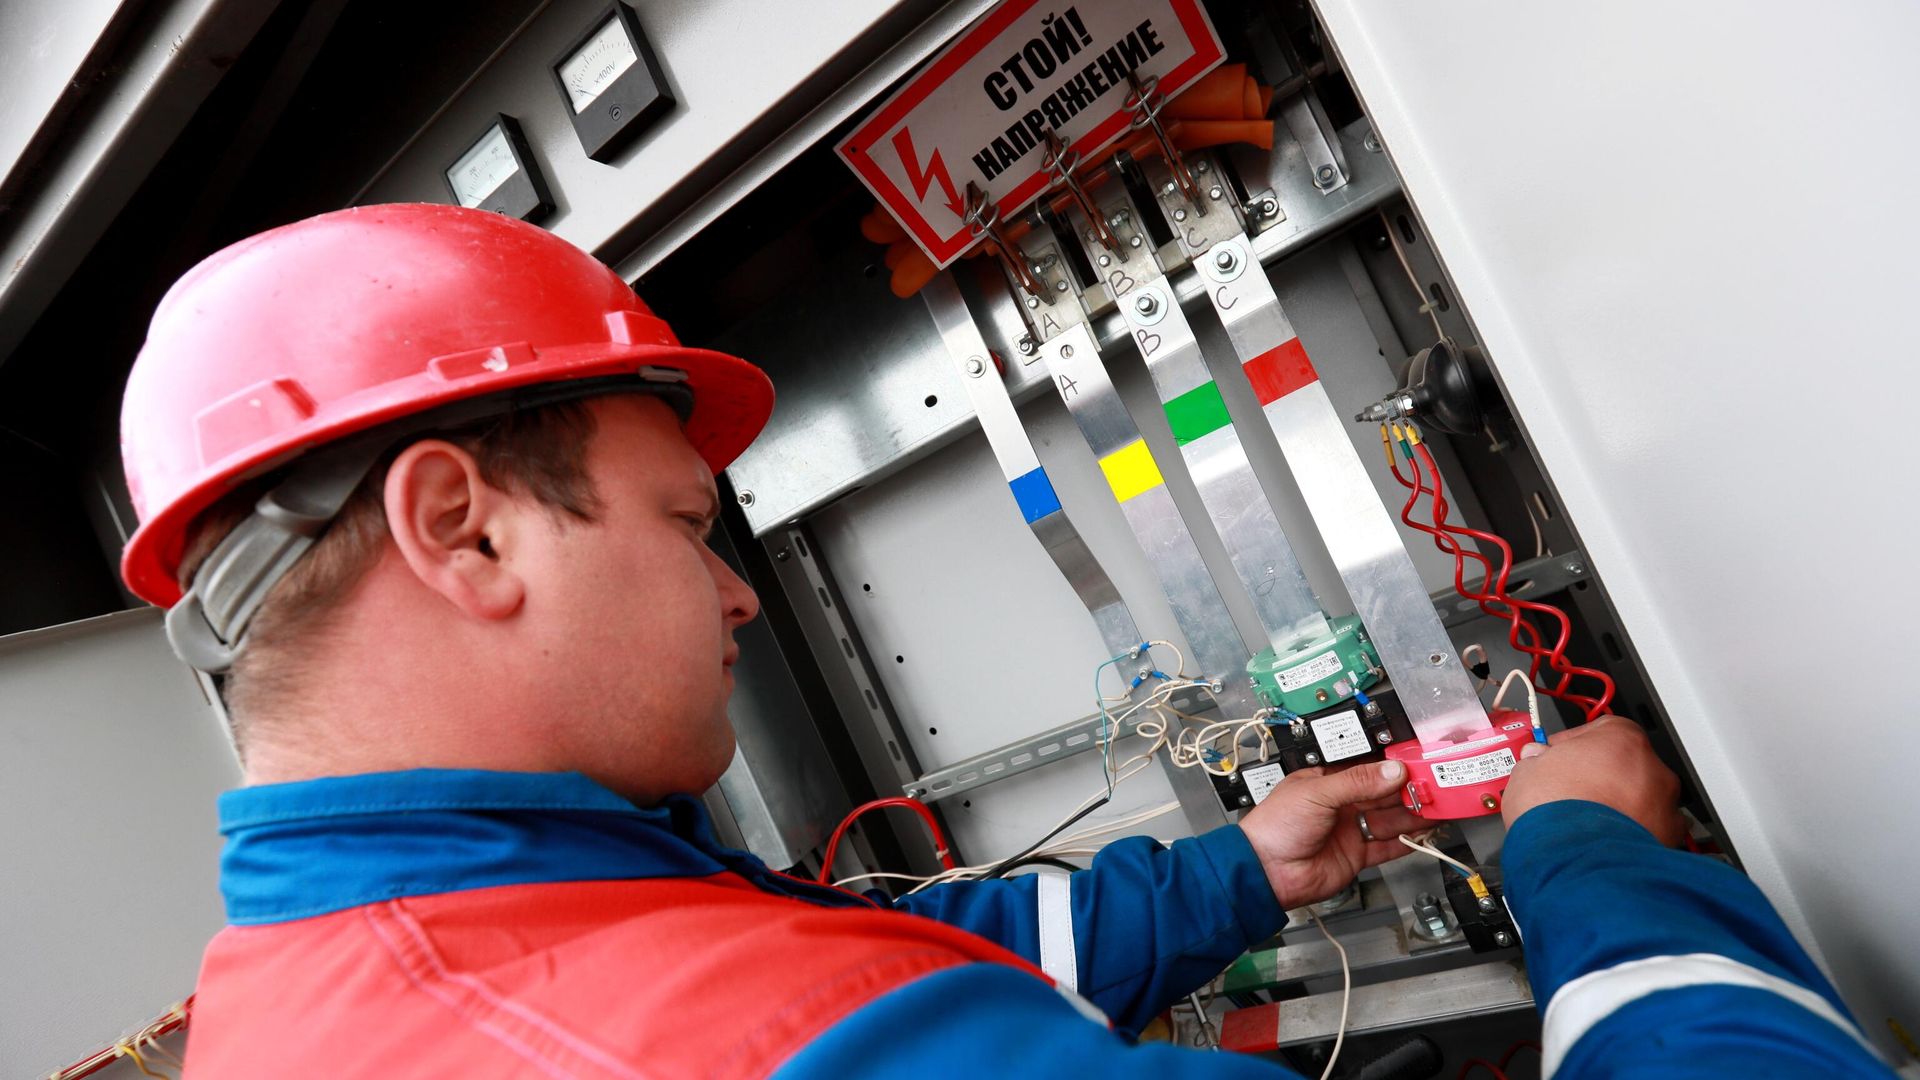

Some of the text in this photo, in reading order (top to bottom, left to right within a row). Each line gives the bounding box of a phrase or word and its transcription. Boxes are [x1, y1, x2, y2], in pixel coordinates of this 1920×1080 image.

[983, 6, 1094, 112] СТОЙ!
[971, 18, 1165, 182] НАПРЯЖЕНИЕ
[1186, 228, 1208, 249] C
[1109, 270, 1135, 297] B
[1216, 285, 1239, 311] C
[1042, 313, 1061, 338] A
[1137, 329, 1161, 357] B
[1058, 374, 1079, 401] A
